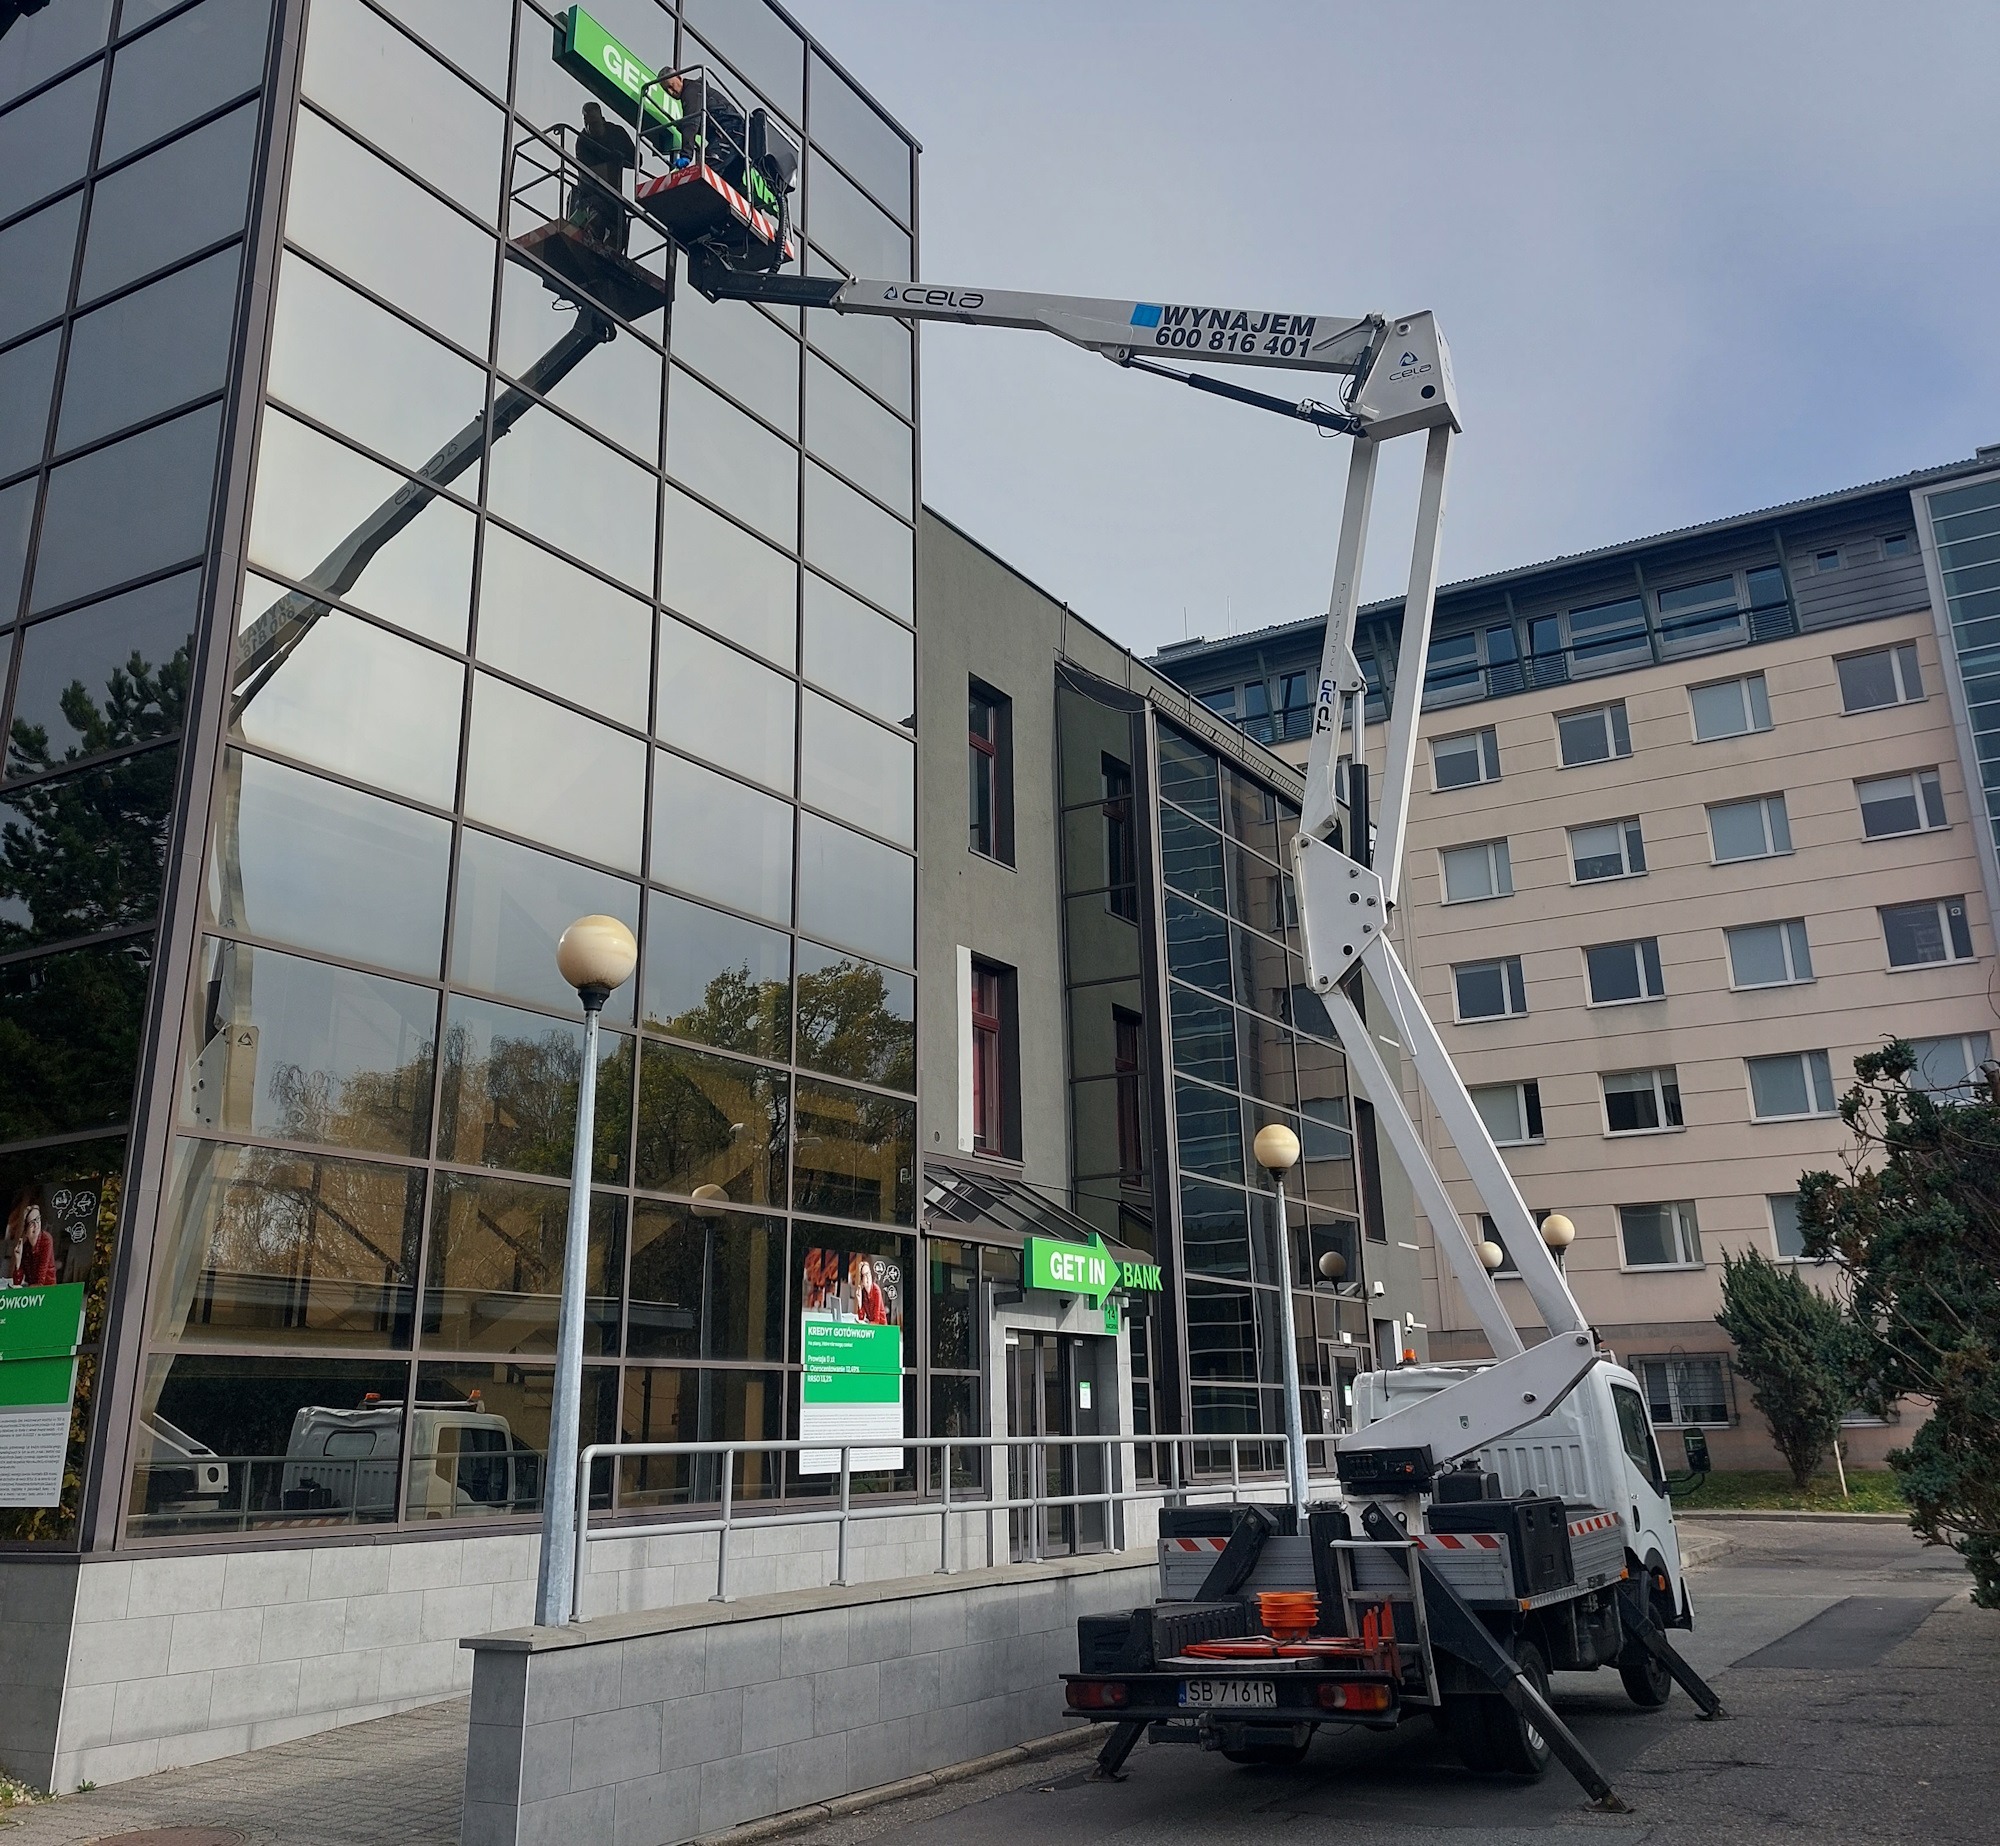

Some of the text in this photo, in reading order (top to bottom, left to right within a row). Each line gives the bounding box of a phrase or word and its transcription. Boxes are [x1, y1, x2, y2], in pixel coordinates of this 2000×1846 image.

[1164, 305, 1316, 337] WYNAJEM
[1155, 326, 1311, 358] 600 816 401
[1049, 1251, 1163, 1291] GET IN BANK
[807, 1326, 875, 1339] KREDYT GOTÓWKOWY
[1189, 1681, 1274, 1703] SB 7161R
